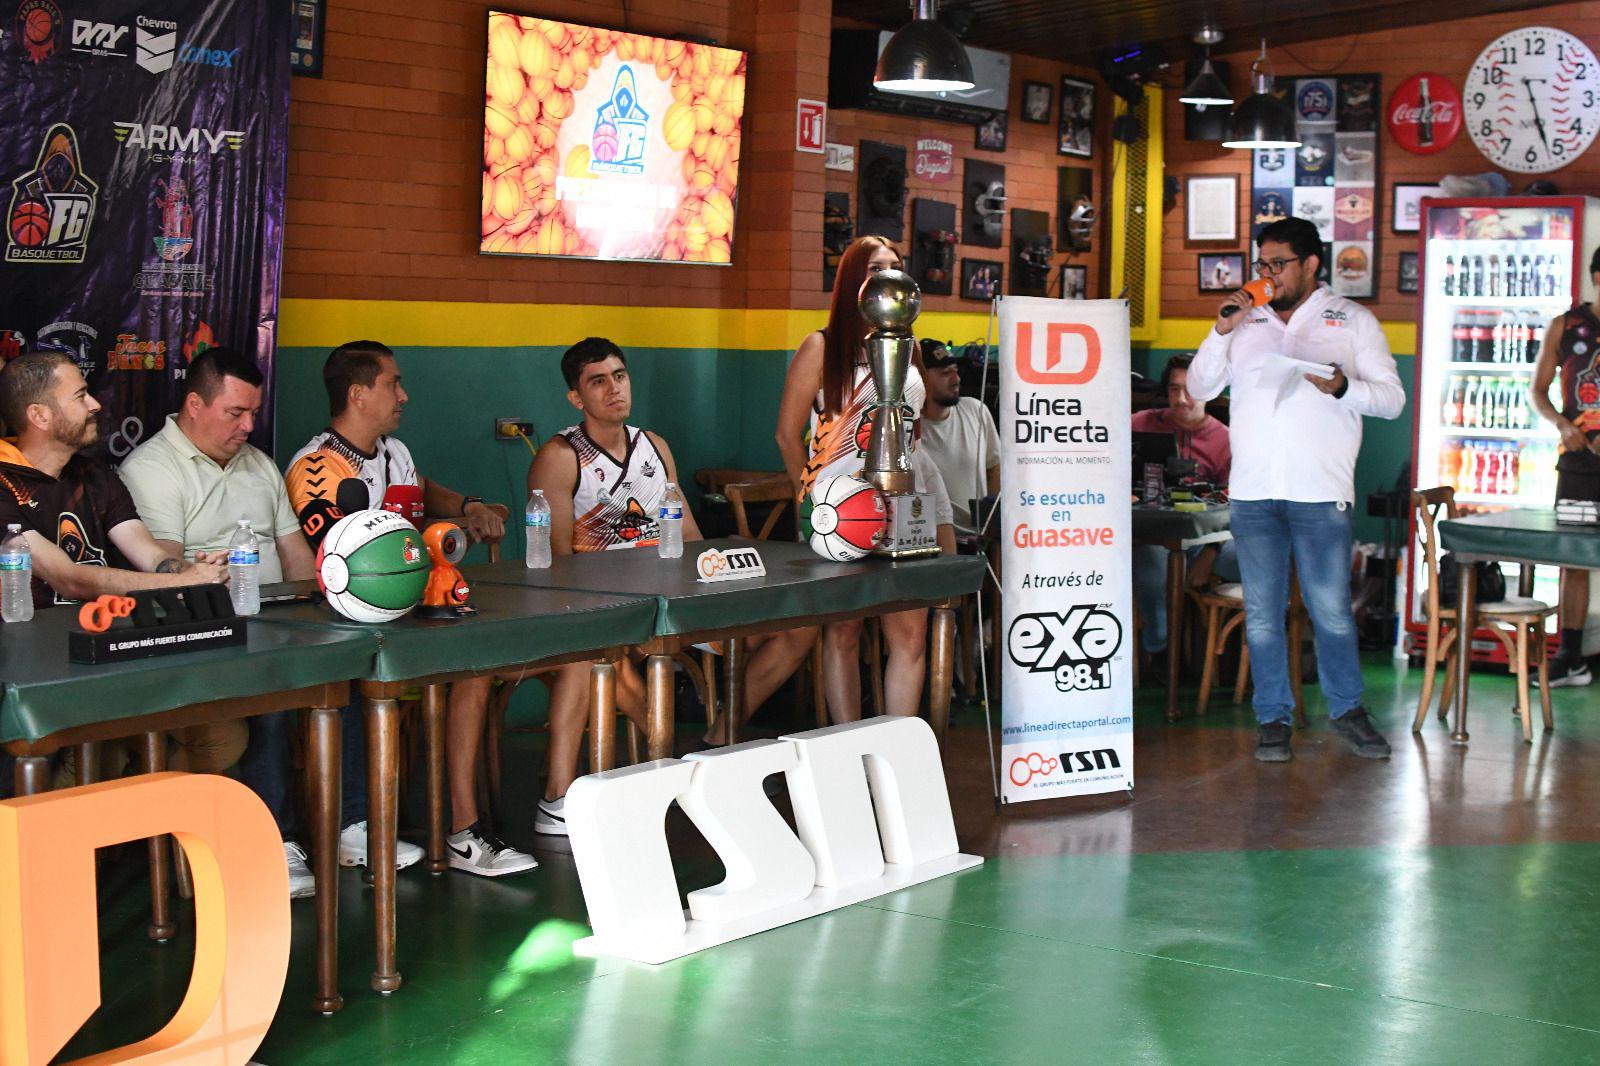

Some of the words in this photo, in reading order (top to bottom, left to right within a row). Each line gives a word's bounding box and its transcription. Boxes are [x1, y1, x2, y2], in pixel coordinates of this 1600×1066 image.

[136, 15, 177, 30] Chevron
[1501, 47, 1518, 64] 11
[1525, 38, 1546, 56] 12
[1556, 44, 1565, 61] 1
[1482, 67, 1503, 85] 10
[1575, 63, 1587, 80] 2
[1473, 92, 1486, 109] 9
[1583, 90, 1594, 108] 3
[1481, 119, 1492, 136] 8
[1570, 118, 1582, 135] 4
[113, 121, 246, 154] ARMY
[1501, 138, 1512, 155] 7
[1552, 138, 1565, 155] 5
[1525, 146, 1537, 163] 6
[1015, 392, 1082, 416] Línea
[1015, 419, 1109, 443] Directa
[1020, 490, 1035, 506] Se
[1040, 489, 1105, 506] escucha
[1051, 510, 1071, 522] en
[1013, 522, 1114, 549] Guasave
[726, 552, 760, 570] rsn
[1022, 573, 1031, 589] A
[1034, 571, 1082, 588] través
[1085, 570, 1104, 587] de
[109, 643, 118, 651] EL
[118, 640, 140, 650] GRUPO
[140, 637, 154, 647] MÁS
[155, 635, 177, 645] FUERTE
[177, 634, 186, 643] EN
[186, 626, 233, 641] COMUNICACIÓN
[1055, 660, 1112, 692] 98.1
[1002, 715, 1131, 736] www.lineadirectaportal.com
[1059, 748, 1121, 774] rsn
